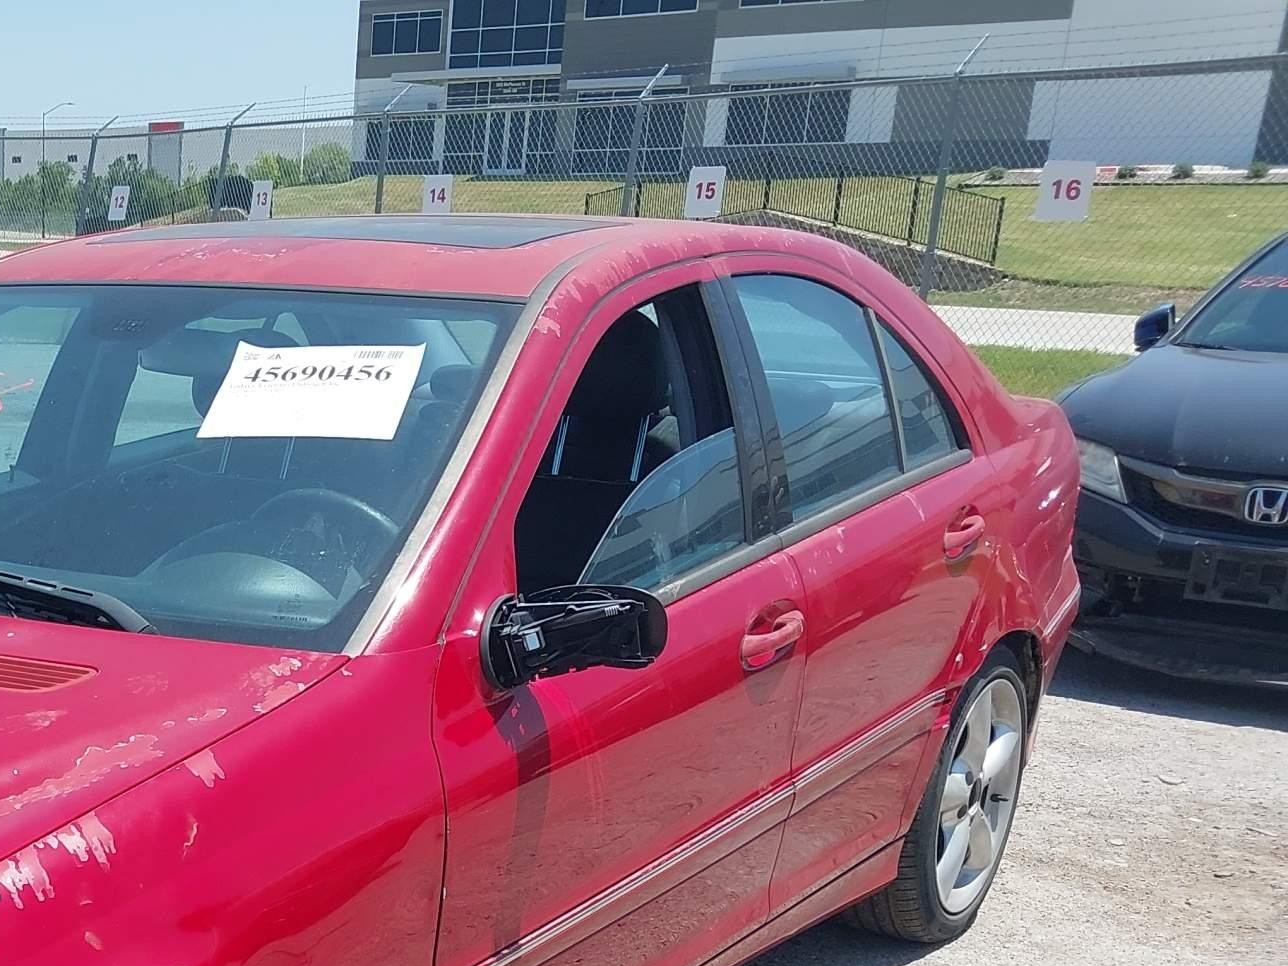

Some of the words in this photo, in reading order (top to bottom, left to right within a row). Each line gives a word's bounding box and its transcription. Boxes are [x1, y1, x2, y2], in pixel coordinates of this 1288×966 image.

[429, 187, 446, 203] 14
[695, 181, 716, 200] 15
[1052, 179, 1081, 200] 16
[114, 196, 125, 209] 12
[256, 192, 268, 206] 13
[244, 365, 394, 383] 45690456
